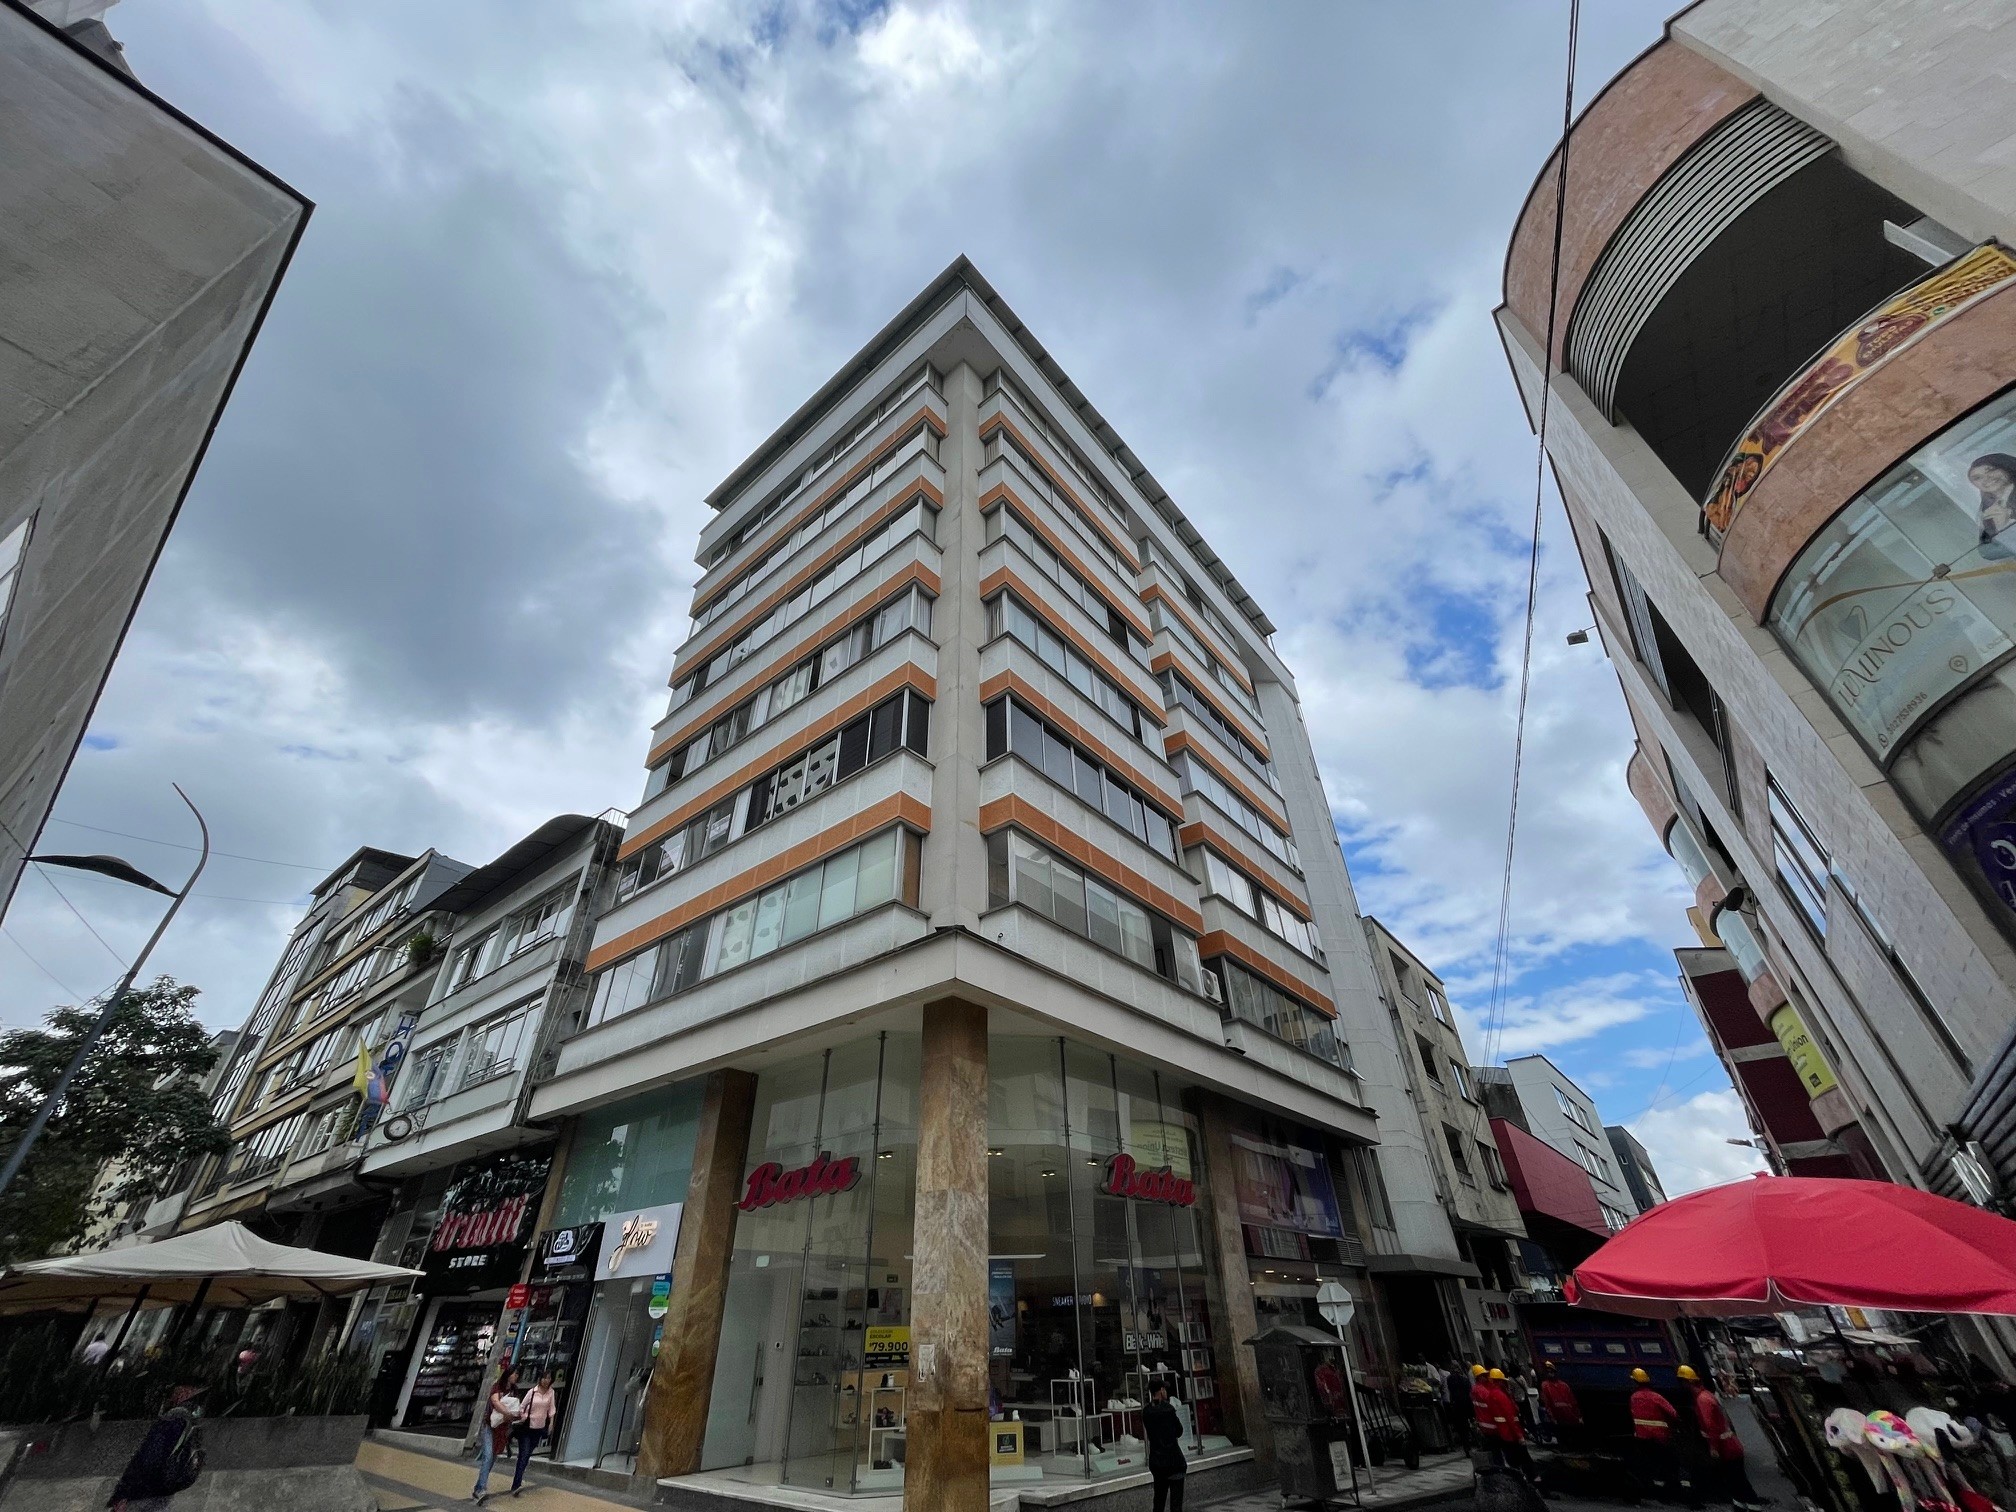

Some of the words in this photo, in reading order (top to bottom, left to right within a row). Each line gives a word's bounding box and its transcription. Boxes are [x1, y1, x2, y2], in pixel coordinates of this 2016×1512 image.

[1838, 588, 1955, 707] LUMINOUS
[736, 1151, 861, 1212] Bata
[1104, 1153, 1196, 1207] Bata
[869, 1341, 909, 1352] $79.900
